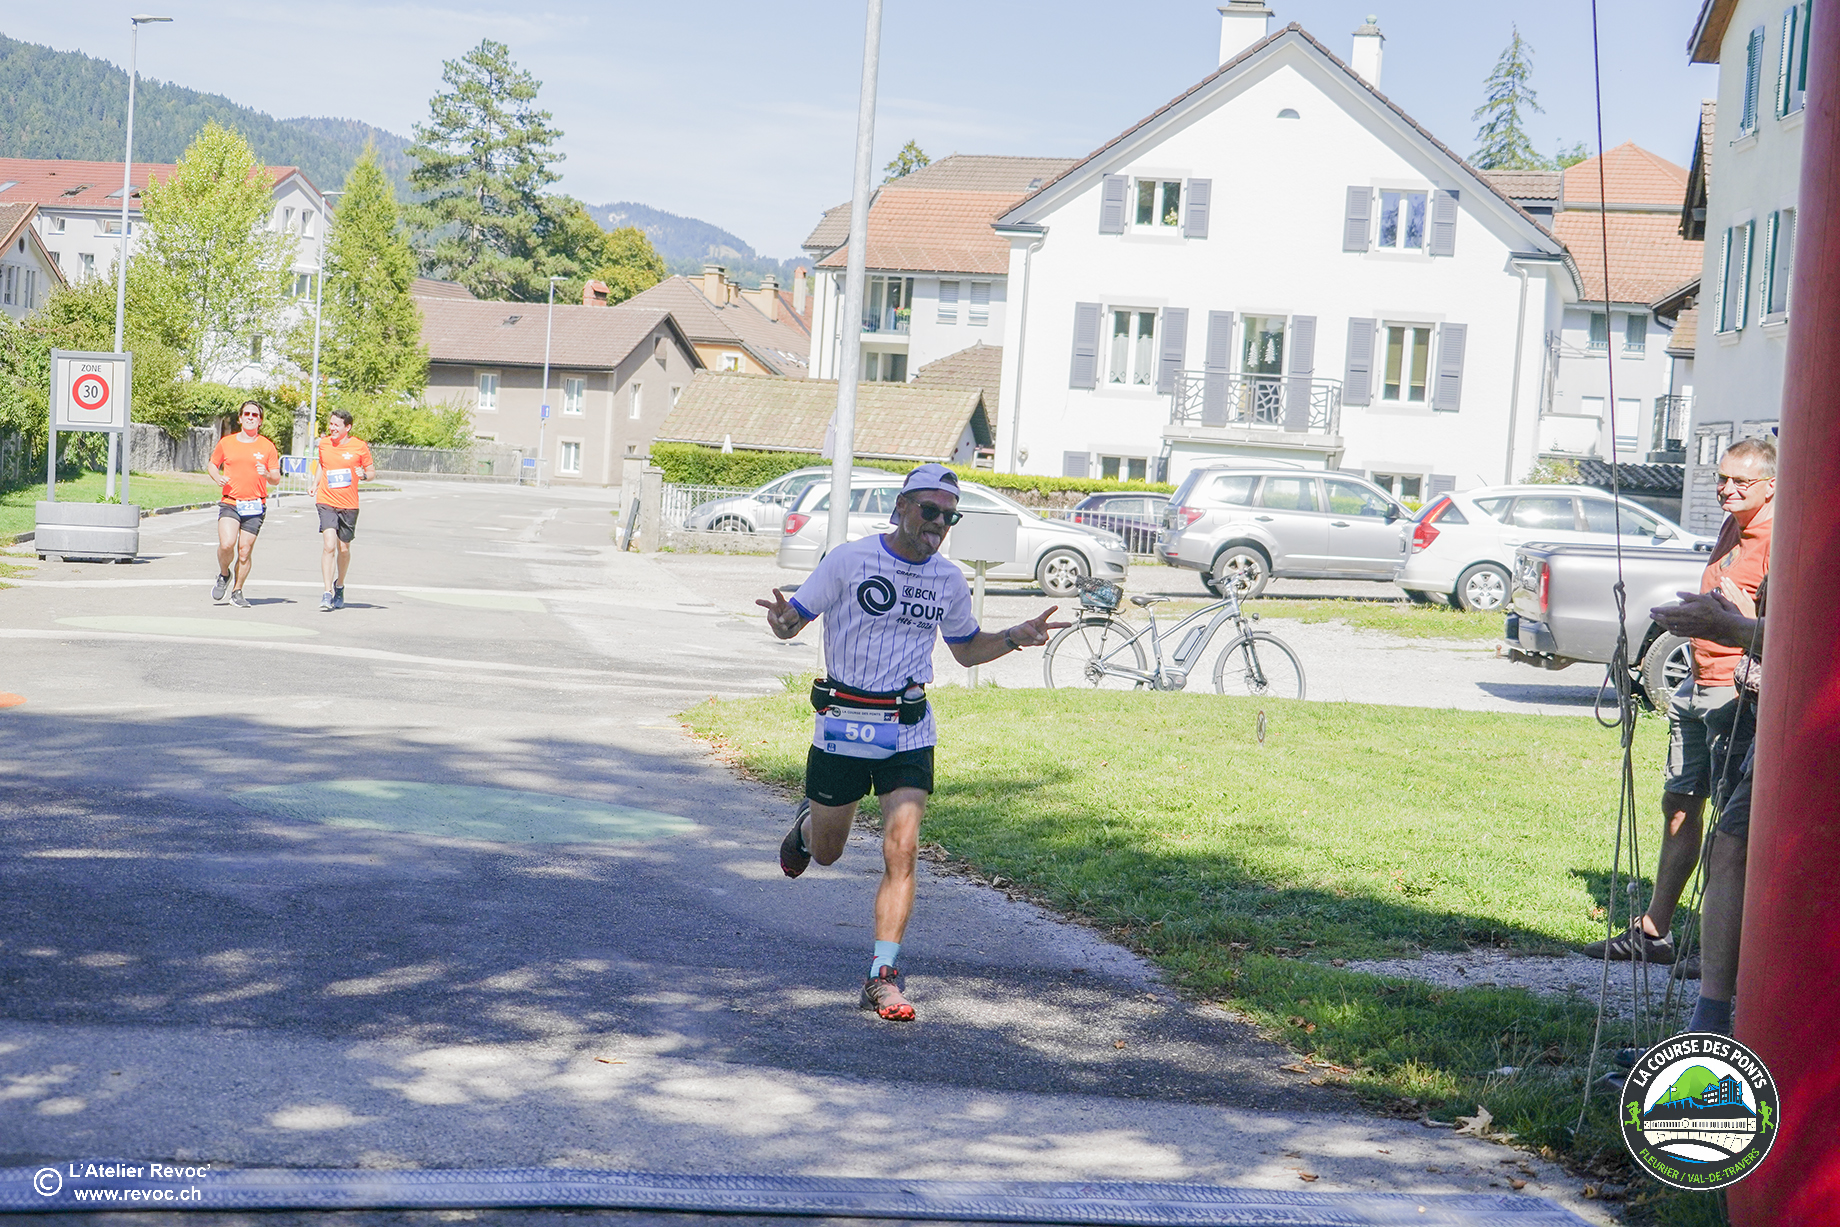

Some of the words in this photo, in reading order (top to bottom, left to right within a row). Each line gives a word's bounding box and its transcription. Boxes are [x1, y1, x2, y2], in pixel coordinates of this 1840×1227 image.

[81, 364, 102, 373] ZONE
[83, 385, 98, 399] 30
[334, 474, 344, 483] 19
[896, 569, 917, 578] CRAFT
[914, 588, 937, 602] BCN
[900, 601, 944, 622] TOUR
[916, 620, 934, 630] 2026
[845, 722, 876, 743] 50
